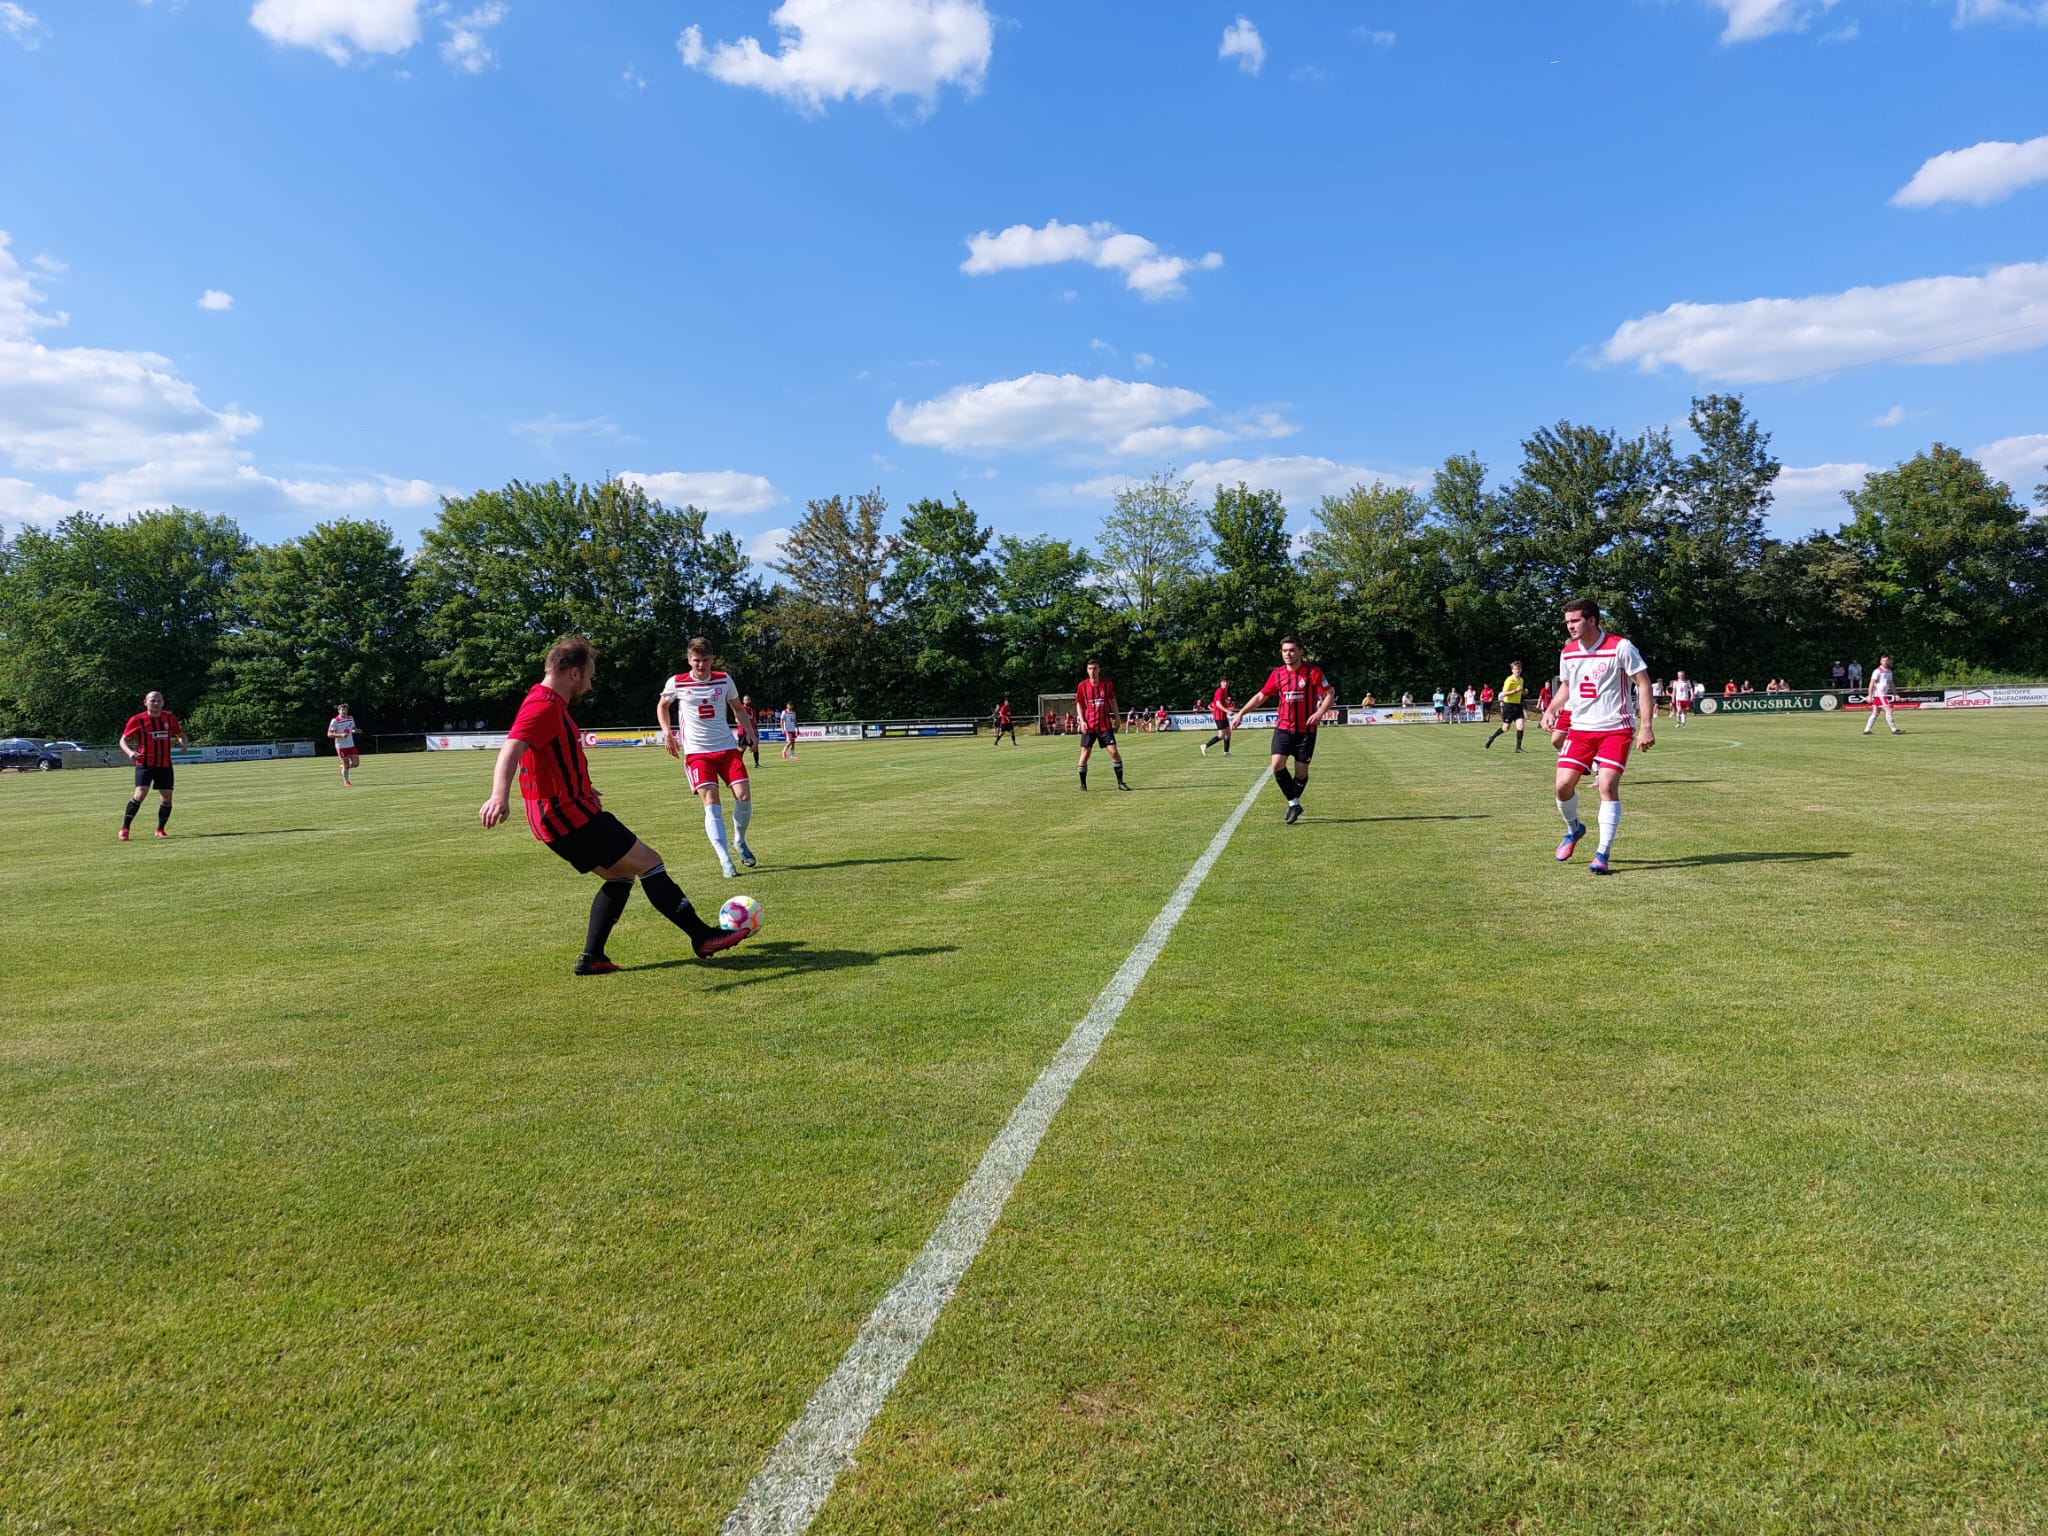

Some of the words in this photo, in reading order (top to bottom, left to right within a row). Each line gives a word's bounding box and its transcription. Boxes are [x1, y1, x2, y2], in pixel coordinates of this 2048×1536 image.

[1722, 697, 1814, 710] KÖNIGSBRÄU
[1174, 715, 1214, 725] Volksbank
[240, 747, 260, 755] GmbH
